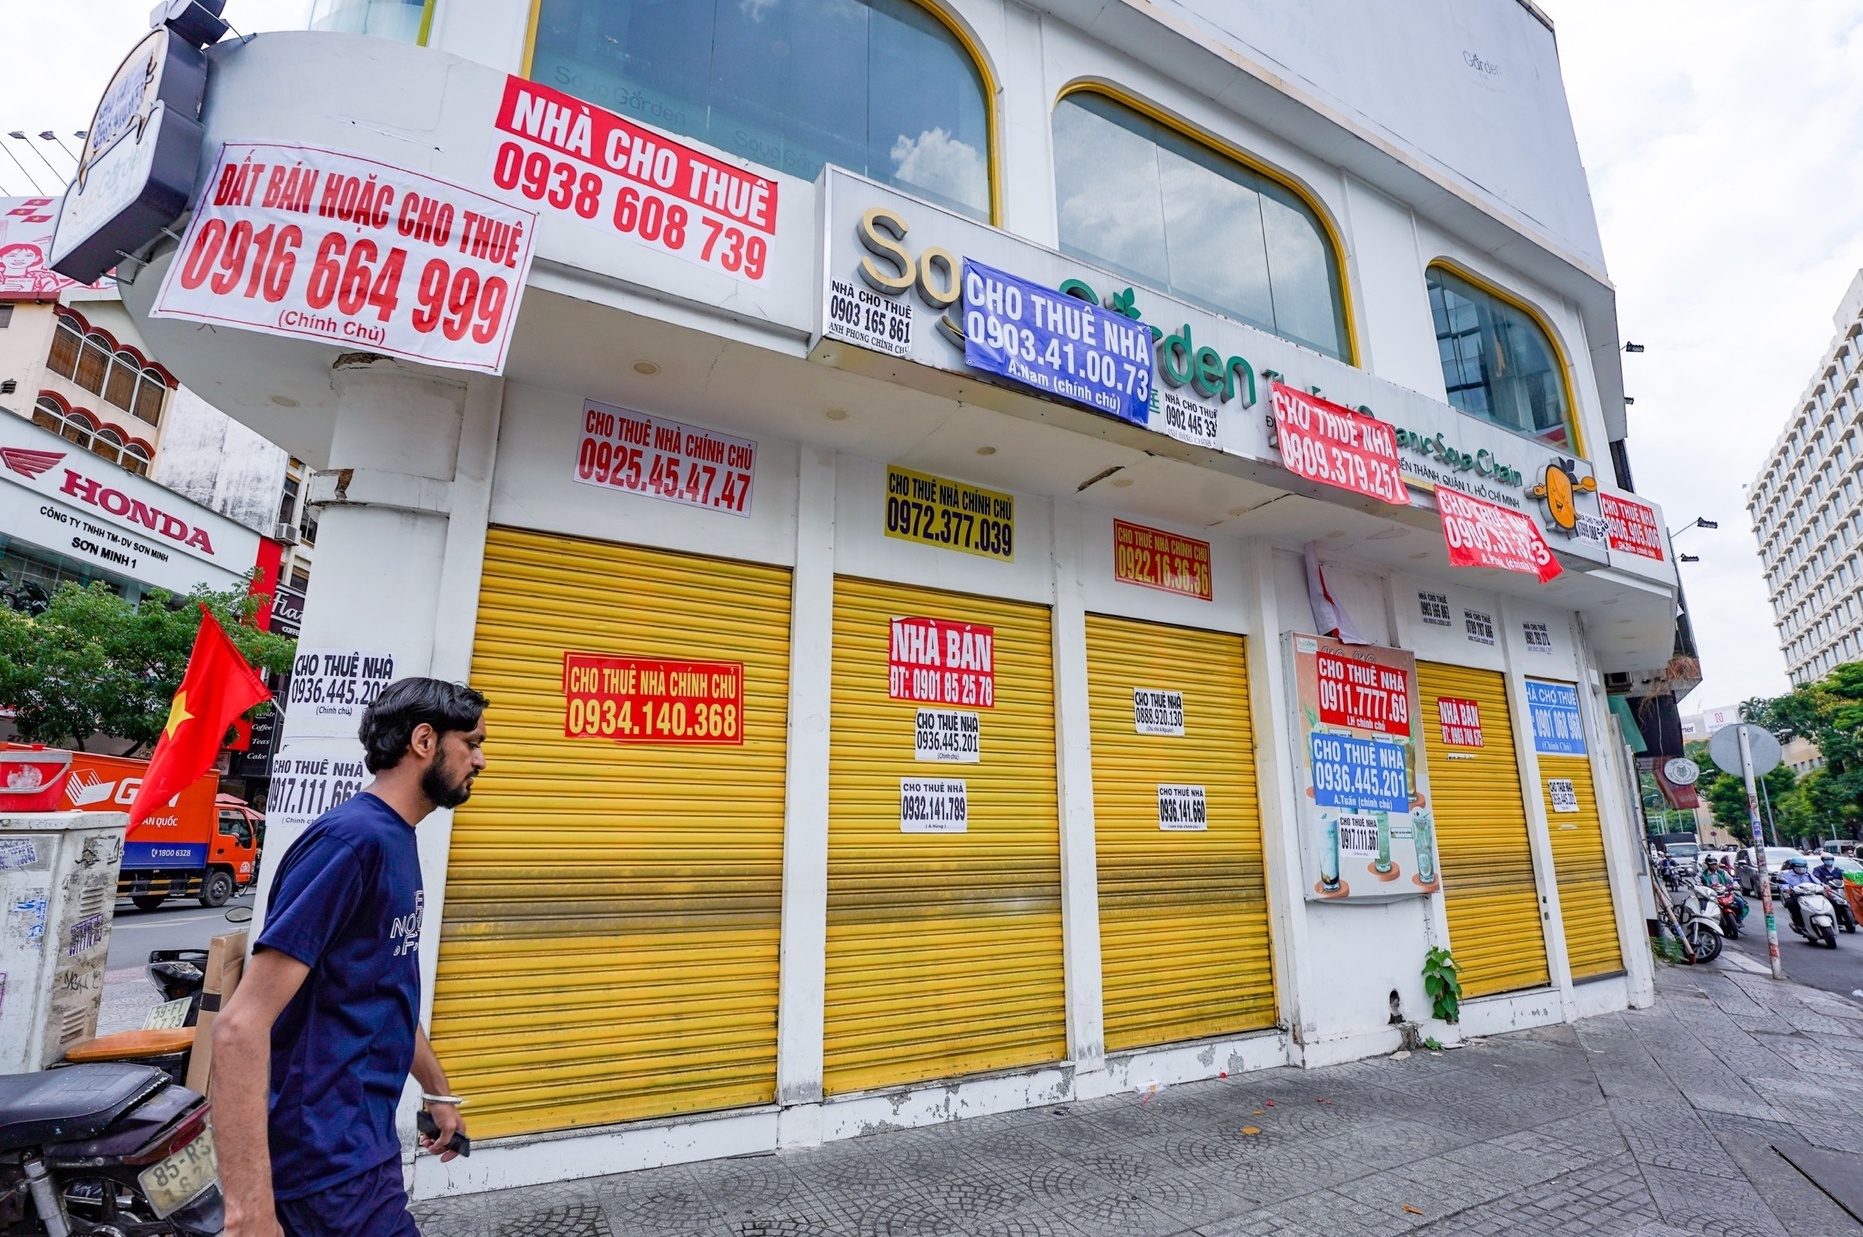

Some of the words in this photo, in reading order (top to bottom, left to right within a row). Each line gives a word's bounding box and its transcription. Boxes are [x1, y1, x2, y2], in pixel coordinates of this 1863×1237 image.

[511, 89, 592, 159] NHÀ
[604, 128, 678, 188] CHO
[688, 158, 770, 227] THUÊ
[213, 149, 265, 206] ĐẤT
[262, 160, 319, 213] BÁN
[318, 172, 394, 233] HOẶC
[397, 191, 454, 247] CHO
[459, 211, 524, 270] THUÊ
[493, 141, 603, 219] 0938
[613, 186, 688, 250] 608
[700, 216, 767, 280] 739
[180, 218, 303, 303] 0916
[305, 231, 408, 323] 664
[411, 258, 509, 345] 999
[832, 280, 854, 299] NHÀ
[858, 290, 881, 308] CHO
[884, 299, 911, 320] THUÊ
[277, 308, 338, 333] (Chính
[343, 321, 387, 346] Chủ)
[831, 295, 861, 327] 0903
[865, 307, 886, 336] 165
[889, 316, 910, 344] 861
[967, 272, 1023, 321] CHO
[1030, 294, 1097, 346] THUÊ
[1103, 320, 1151, 367] NHÀ
[829, 322, 844, 335] ANH
[846, 327, 870, 344] PHONG
[871, 336, 893, 352] CHÍNH
[967, 311, 1149, 402] 0903.41.00.73
[1008, 358, 1049, 388] A.Nam
[1053, 375, 1092, 401] (chính
[1095, 390, 1122, 415] chủ)
[1165, 393, 1181, 407] NHÀ
[1182, 400, 1198, 413] CHO
[1199, 406, 1218, 419] THUÊ
[1166, 405, 1186, 431] 0902
[1187, 413, 1203, 436] 445
[585, 409, 615, 438] CHO
[618, 416, 652, 447] THUÊ
[654, 426, 681, 455] NHÀ
[685, 433, 726, 465] CHÍNH
[727, 444, 753, 470] CHỦ
[1273, 390, 1311, 430] CHO
[1315, 412, 1358, 447] THUÊ
[1362, 424, 1395, 460] NHÀ
[578, 437, 751, 512] 0925.45.47.47
[1434, 432, 1475, 474] Soya
[1475, 448, 1524, 488] Chain
[889, 472, 909, 497] CHO
[912, 478, 937, 504] THUÊ
[939, 484, 960, 510] NHÀ
[962, 489, 991, 517] CHÍNH
[993, 497, 1012, 521] CHỦ
[1438, 490, 1473, 516] CHO
[1443, 476, 1465, 493] QUẬN
[1474, 484, 1488, 498] HỒ
[1488, 489, 1502, 502] CHÍ
[1502, 494, 1521, 509] MINH
[59, 468, 215, 555] HONDA
[887, 496, 1012, 557] 0972.377.039
[1603, 497, 1618, 516] CHO
[1620, 502, 1639, 523] THUÊ
[1641, 507, 1655, 528] NHÀ
[40, 505, 68, 524] CÔNG
[69, 516, 82, 529] TY
[82, 521, 107, 540] TNHH
[133, 541, 150, 556] SƠN
[150, 548, 169, 564] MINH
[1118, 527, 1133, 544] CHO
[1134, 531, 1153, 549] THUÊ
[1154, 535, 1170, 553] NHÀ
[1171, 539, 1193, 558] CHÍNH
[1193, 545, 1207, 562] CHỦ
[71, 535, 99, 555] SƠN
[100, 546, 131, 567] MINH
[131, 559, 138, 570] 1
[271, 590, 303, 621] Fla
[1418, 591, 1427, 600] NHÀ
[1427, 594, 1437, 602] CHO
[1436, 595, 1448, 604] THUÊ
[1465, 611, 1473, 619] NHÀ
[1473, 613, 1482, 621] CHO
[1481, 614, 1492, 624] THUÊ
[1523, 622, 1531, 630] NHÀ
[1537, 623, 1547, 632] THUÊ
[892, 620, 940, 667] NHÀ
[945, 624, 992, 672] BÁN
[295, 654, 319, 677] CHO
[324, 651, 360, 678] THUÊ
[361, 654, 394, 680] NHÀ
[570, 666, 599, 694] CHO
[602, 663, 637, 695] THUÊ
[640, 664, 666, 696] NHÀ
[669, 667, 708, 698] CHÍNH
[711, 667, 736, 699] CHỦ
[1318, 657, 1344, 680] CHO
[1347, 665, 1381, 687] THUÊ
[1381, 670, 1405, 693] NHÀ
[890, 665, 909, 698] ĐT:
[912, 668, 940, 700] 0901
[944, 671, 960, 703] 85
[961, 673, 976, 705] 25
[1134, 691, 1149, 706] CHO
[1150, 691, 1166, 708] THUÊ
[1167, 693, 1182, 710] NHÀ
[1539, 687, 1557, 703] CHO
[1557, 689, 1577, 706] THUÊ
[569, 698, 737, 737] 0934.140.368
[1320, 679, 1408, 724] 0911.7777.69
[1438, 699, 1460, 726] NHÀ
[1459, 701, 1480, 727] BÁN
[251, 723, 273, 732] Coffee
[916, 712, 935, 730] CHO
[937, 711, 959, 731] THUÊ
[960, 713, 978, 733] NHÀ
[1347, 715, 1355, 726] LH
[1356, 716, 1373, 729] chính
[247, 752, 267, 760] Cake
[252, 738, 270, 746] Teas
[916, 730, 978, 753] 0936.445.201
[1313, 738, 1341, 759] CHO
[1344, 743, 1377, 766] THUÊ
[1380, 745, 1405, 770] NHÀ
[273, 760, 293, 774] CHO
[295, 759, 329, 776] THUÊ
[333, 761, 364, 778] NHÀ
[1315, 763, 1406, 799] 0936.445.201
[903, 783, 921, 793] CHO
[923, 781, 945, 793] THUÊ
[947, 782, 964, 793] NHÀ
[1159, 787, 1173, 796] CHO
[1174, 786, 1190, 797] THUÊ
[1191, 787, 1203, 797] NHÀ
[1334, 794, 1357, 808] A.Tuấn
[1358, 796, 1378, 811] (chính
[1379, 799, 1393, 812] chủ)
[156, 815, 178, 828] QUỐC
[902, 795, 965, 821] 0932.141.789
[1340, 817, 1351, 827] CHO
[1352, 817, 1365, 827] THUÊ
[1365, 818, 1378, 828] NHÀ
[159, 849, 174, 857] 1800
[175, 849, 191, 857] 6328
[1341, 827, 1379, 851] 0917.111.661
[153, 1137, 211, 1187] 85-R3
